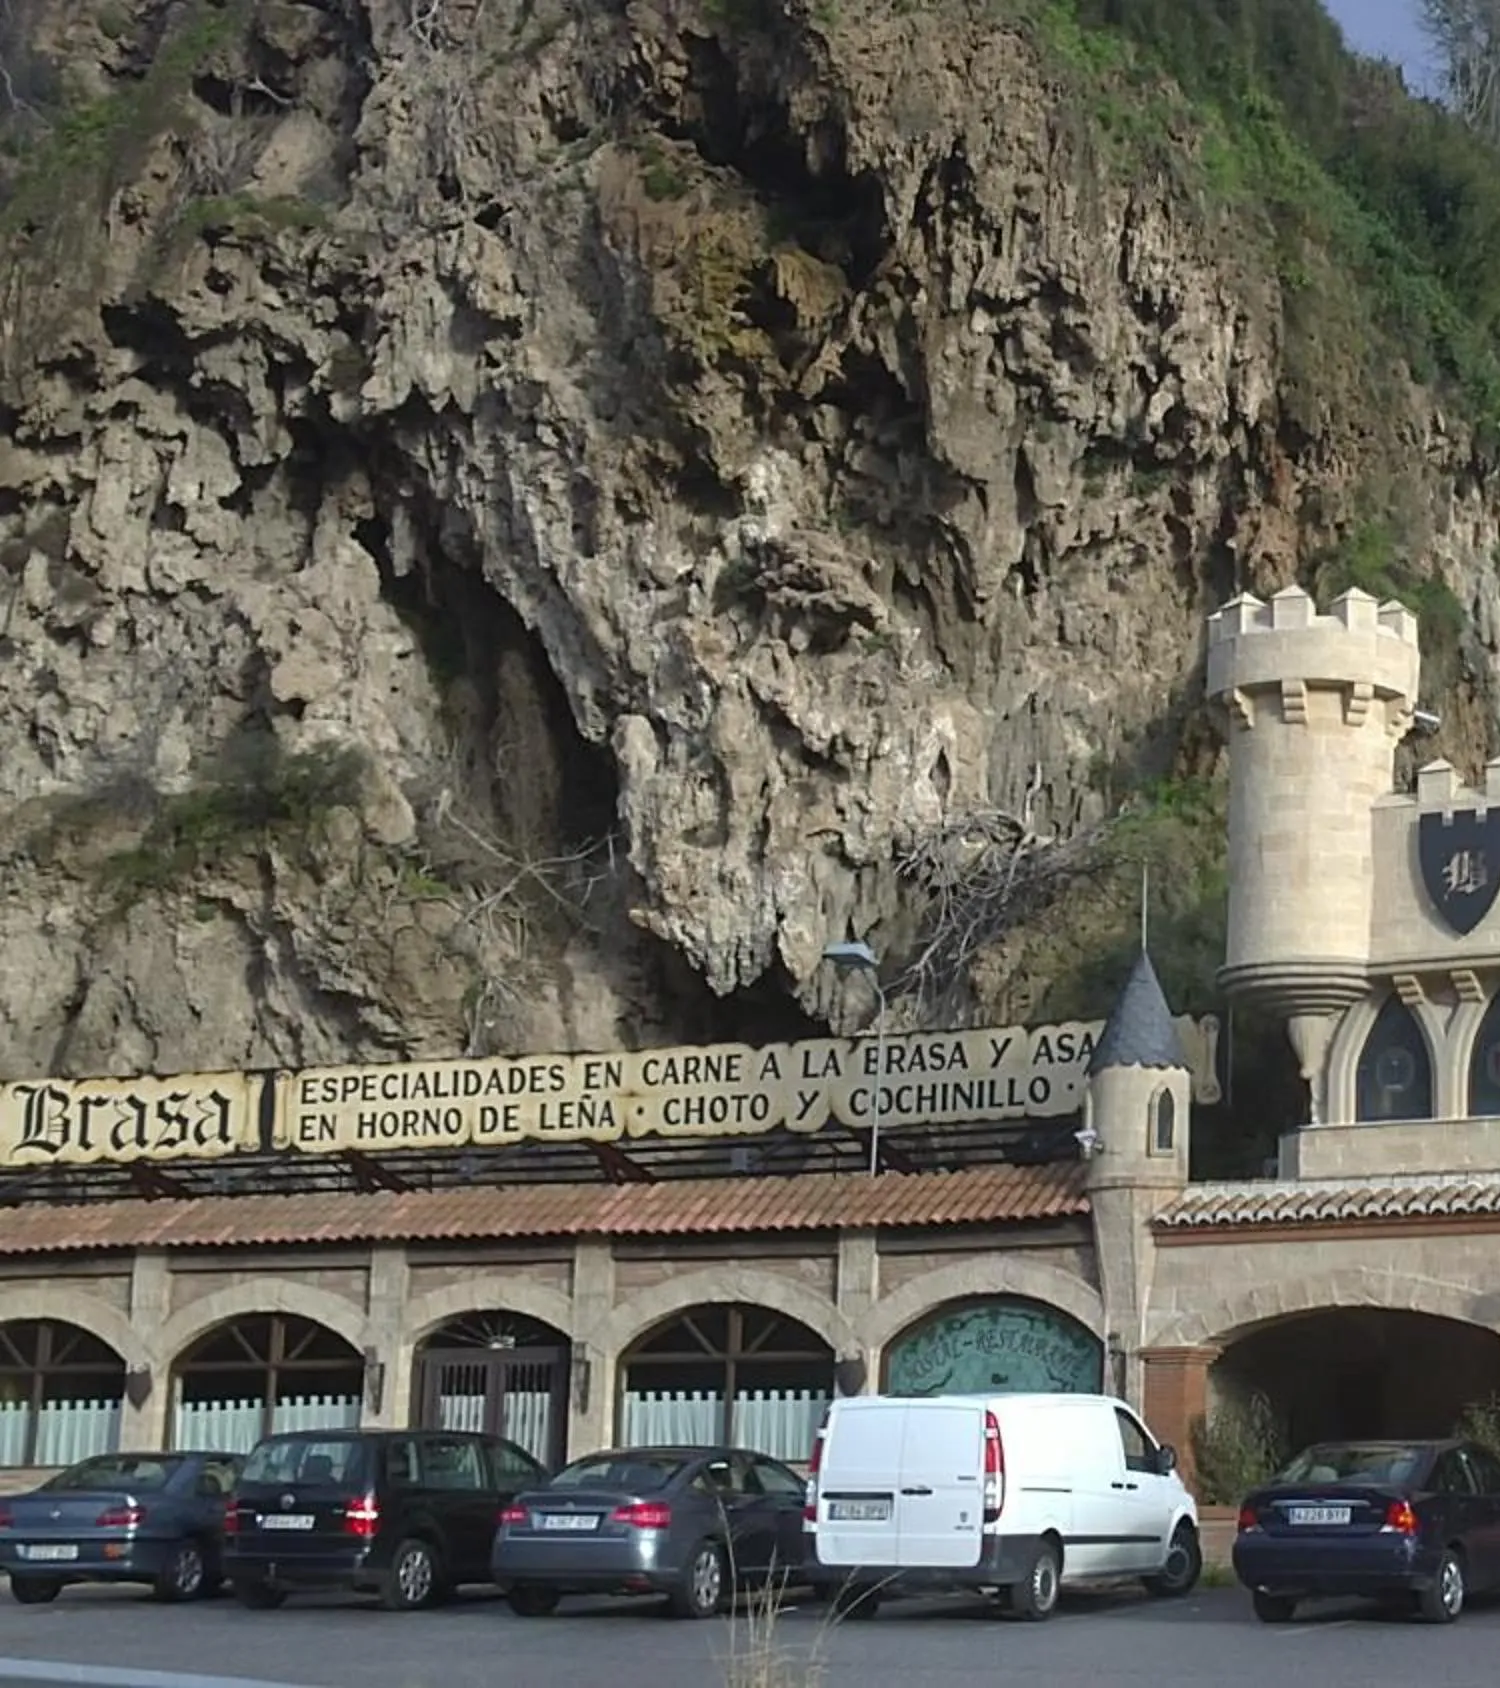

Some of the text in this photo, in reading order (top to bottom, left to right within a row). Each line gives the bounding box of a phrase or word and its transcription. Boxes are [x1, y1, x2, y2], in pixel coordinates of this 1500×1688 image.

[301, 1032, 1097, 1105] ESPECIALIDADES EN CARNE A LA BRASA Y ASA
[12, 1084, 232, 1161] Brasa
[299, 1075, 1051, 1143] EN HORNO DE LEÑA CHOTO Y COCHINILLO
